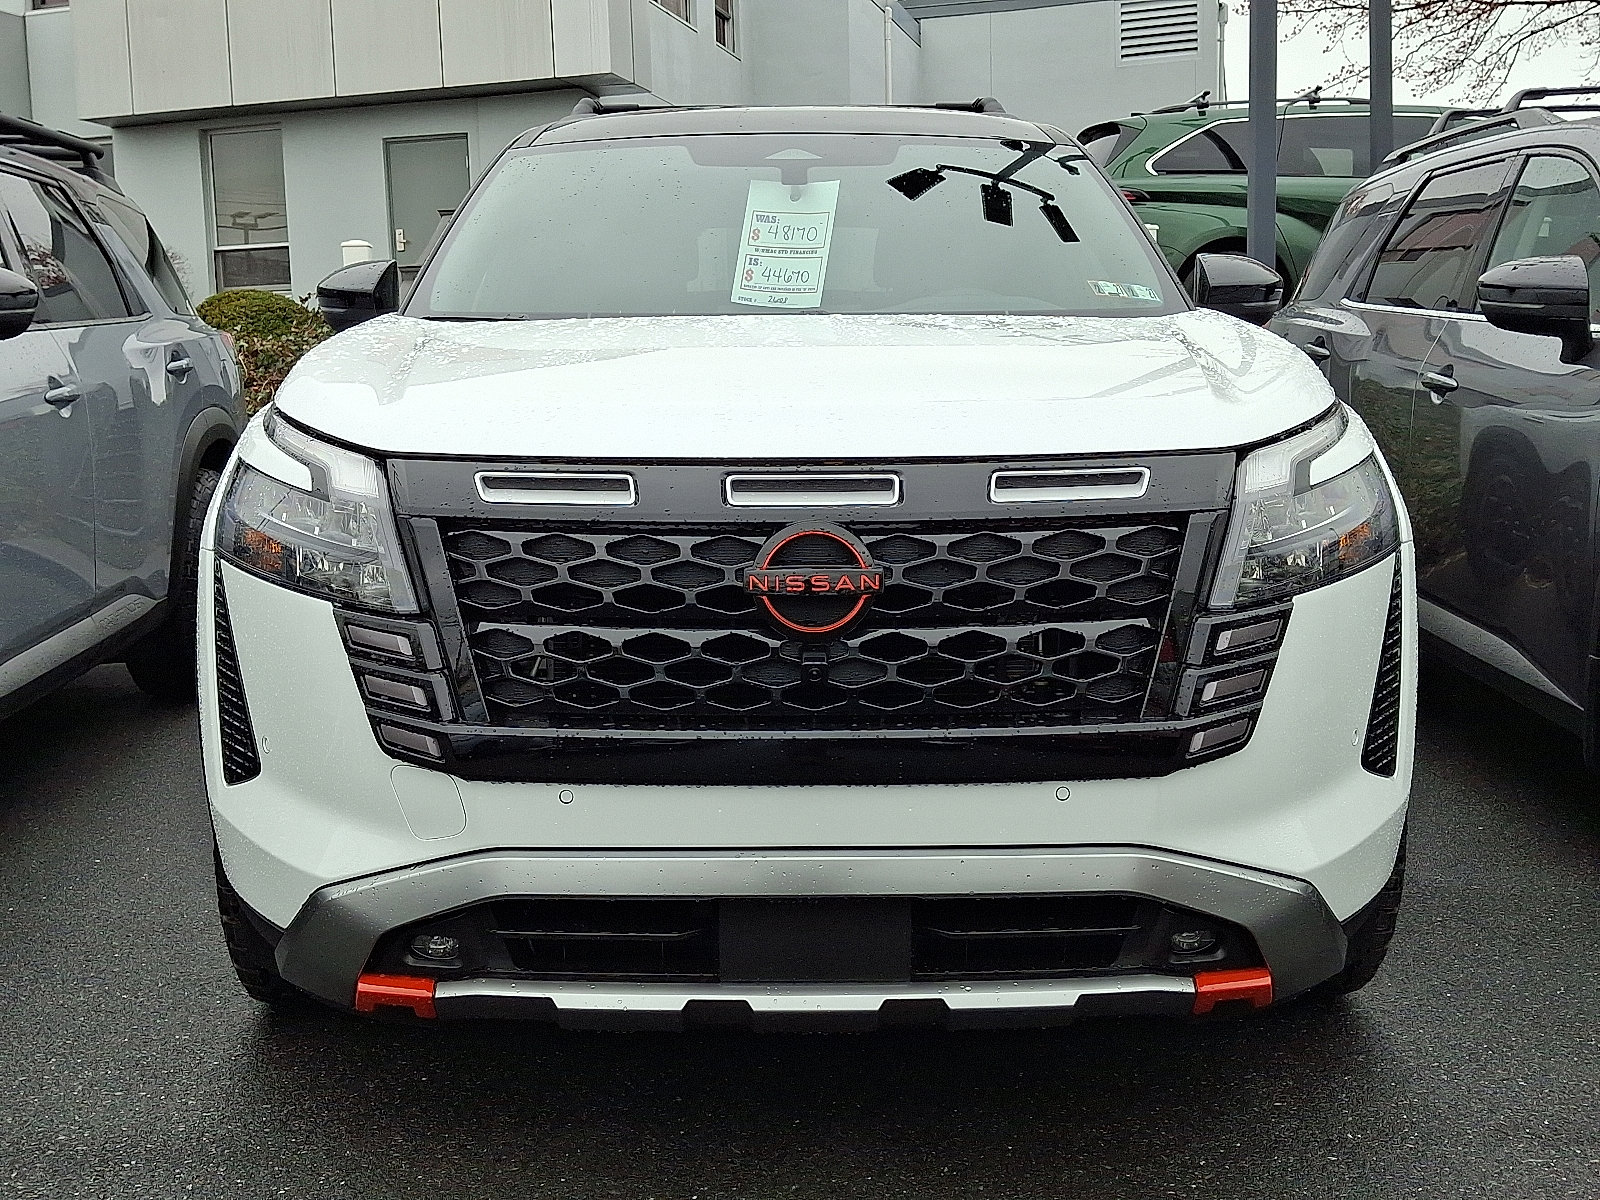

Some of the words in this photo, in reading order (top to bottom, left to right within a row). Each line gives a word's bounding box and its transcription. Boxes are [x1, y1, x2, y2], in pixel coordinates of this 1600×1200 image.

[755, 214, 781, 224] WAS:
[751, 227, 761, 242] $
[767, 225, 818, 242] 48170
[748, 257, 763, 267] IS:
[744, 268, 755, 283] $
[761, 266, 810, 283] 44670
[748, 573, 880, 592] NISSAN
